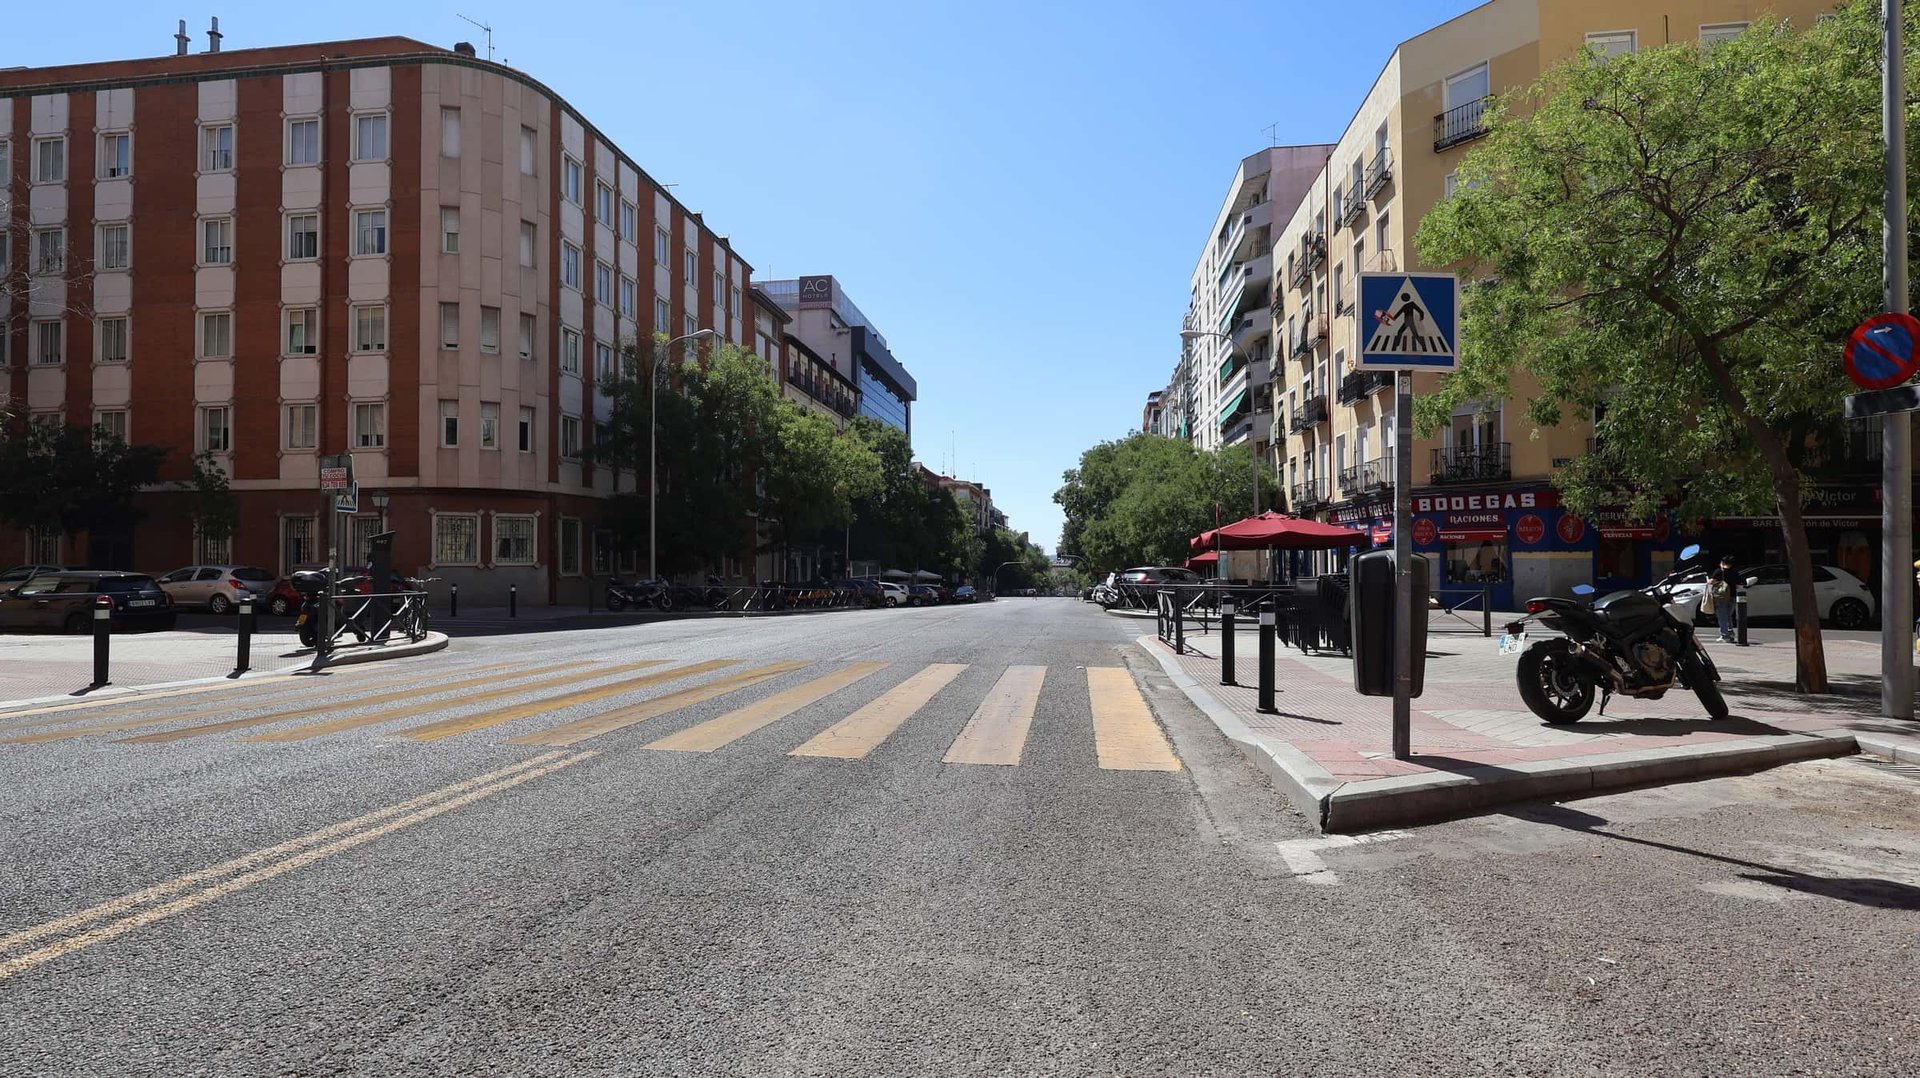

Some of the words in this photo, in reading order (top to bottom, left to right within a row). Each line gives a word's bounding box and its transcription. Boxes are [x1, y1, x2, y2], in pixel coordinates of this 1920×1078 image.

[803, 279, 828, 292] AC
[1418, 493, 1535, 512] BODEGAS
[1337, 507, 1367, 521] BODEGAS
[1449, 515, 1499, 524] RACIONES
